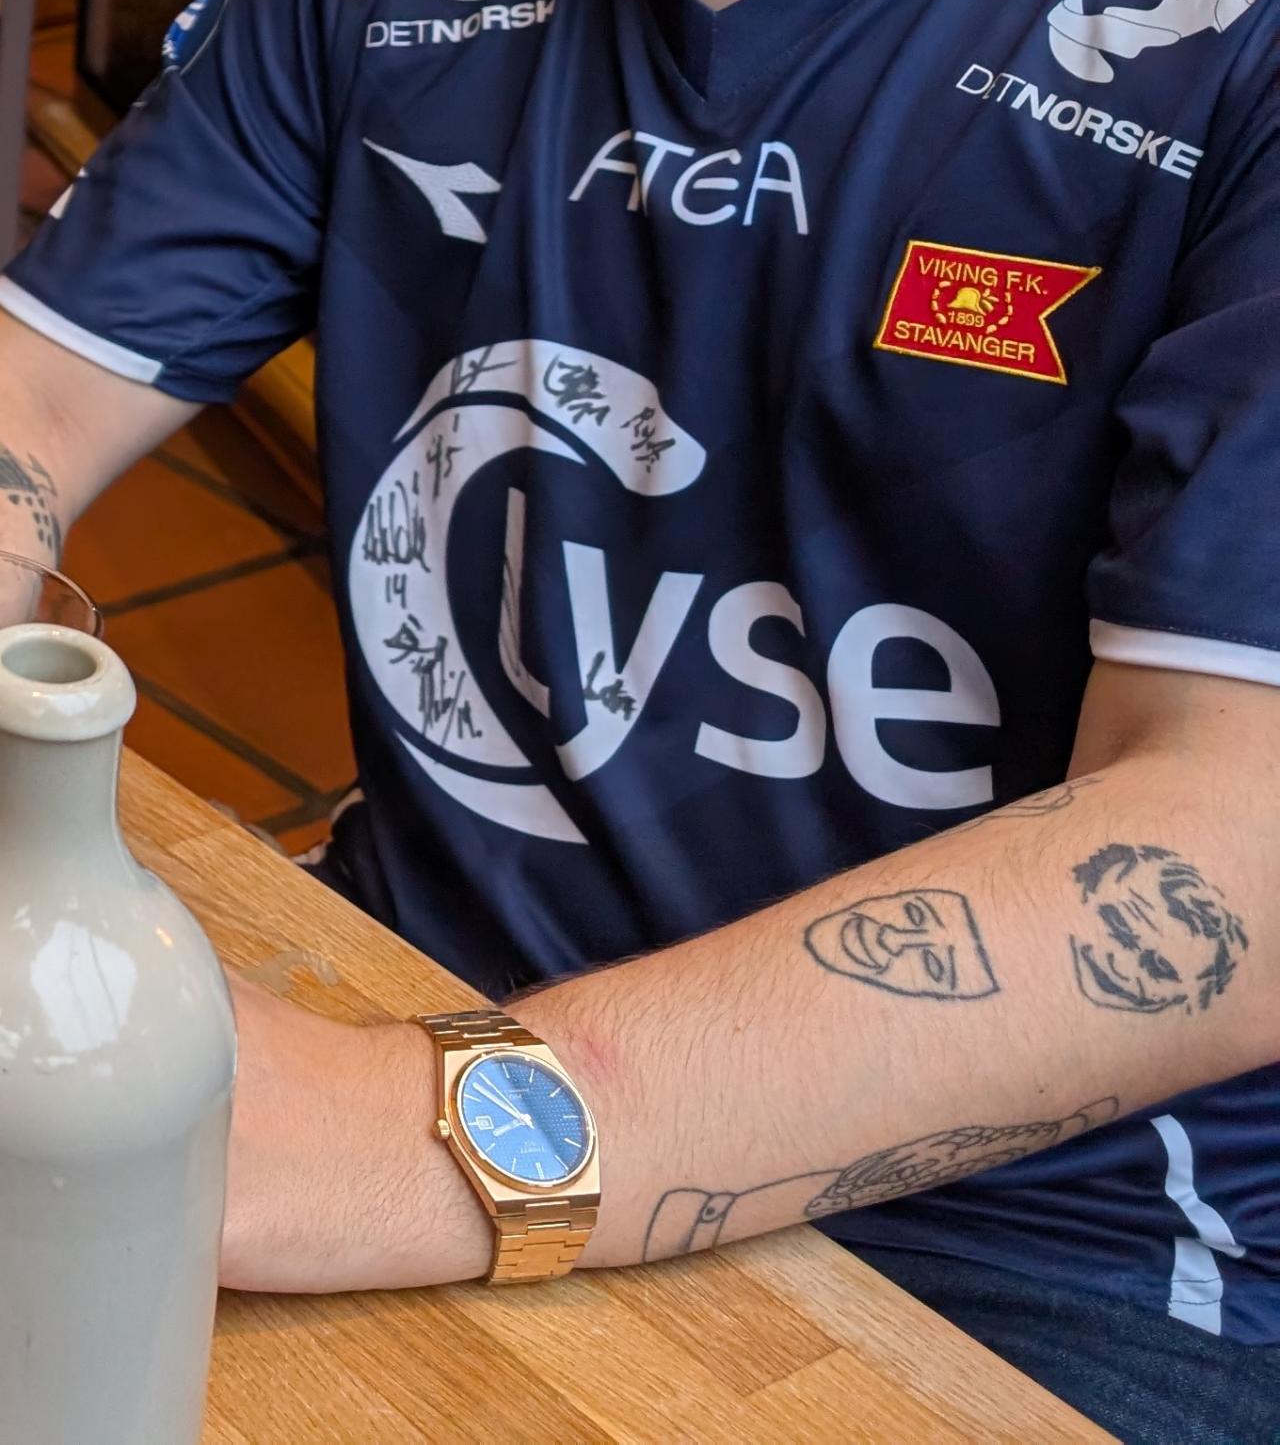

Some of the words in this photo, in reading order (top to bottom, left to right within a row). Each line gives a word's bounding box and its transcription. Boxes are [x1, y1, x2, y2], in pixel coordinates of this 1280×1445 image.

[568, 130, 809, 236] ATEA
[918, 255, 999, 288] VIKING
[1005, 269, 1048, 295] F.K.
[947, 310, 985, 328] 1899
[893, 319, 1036, 364] STAVANGER
